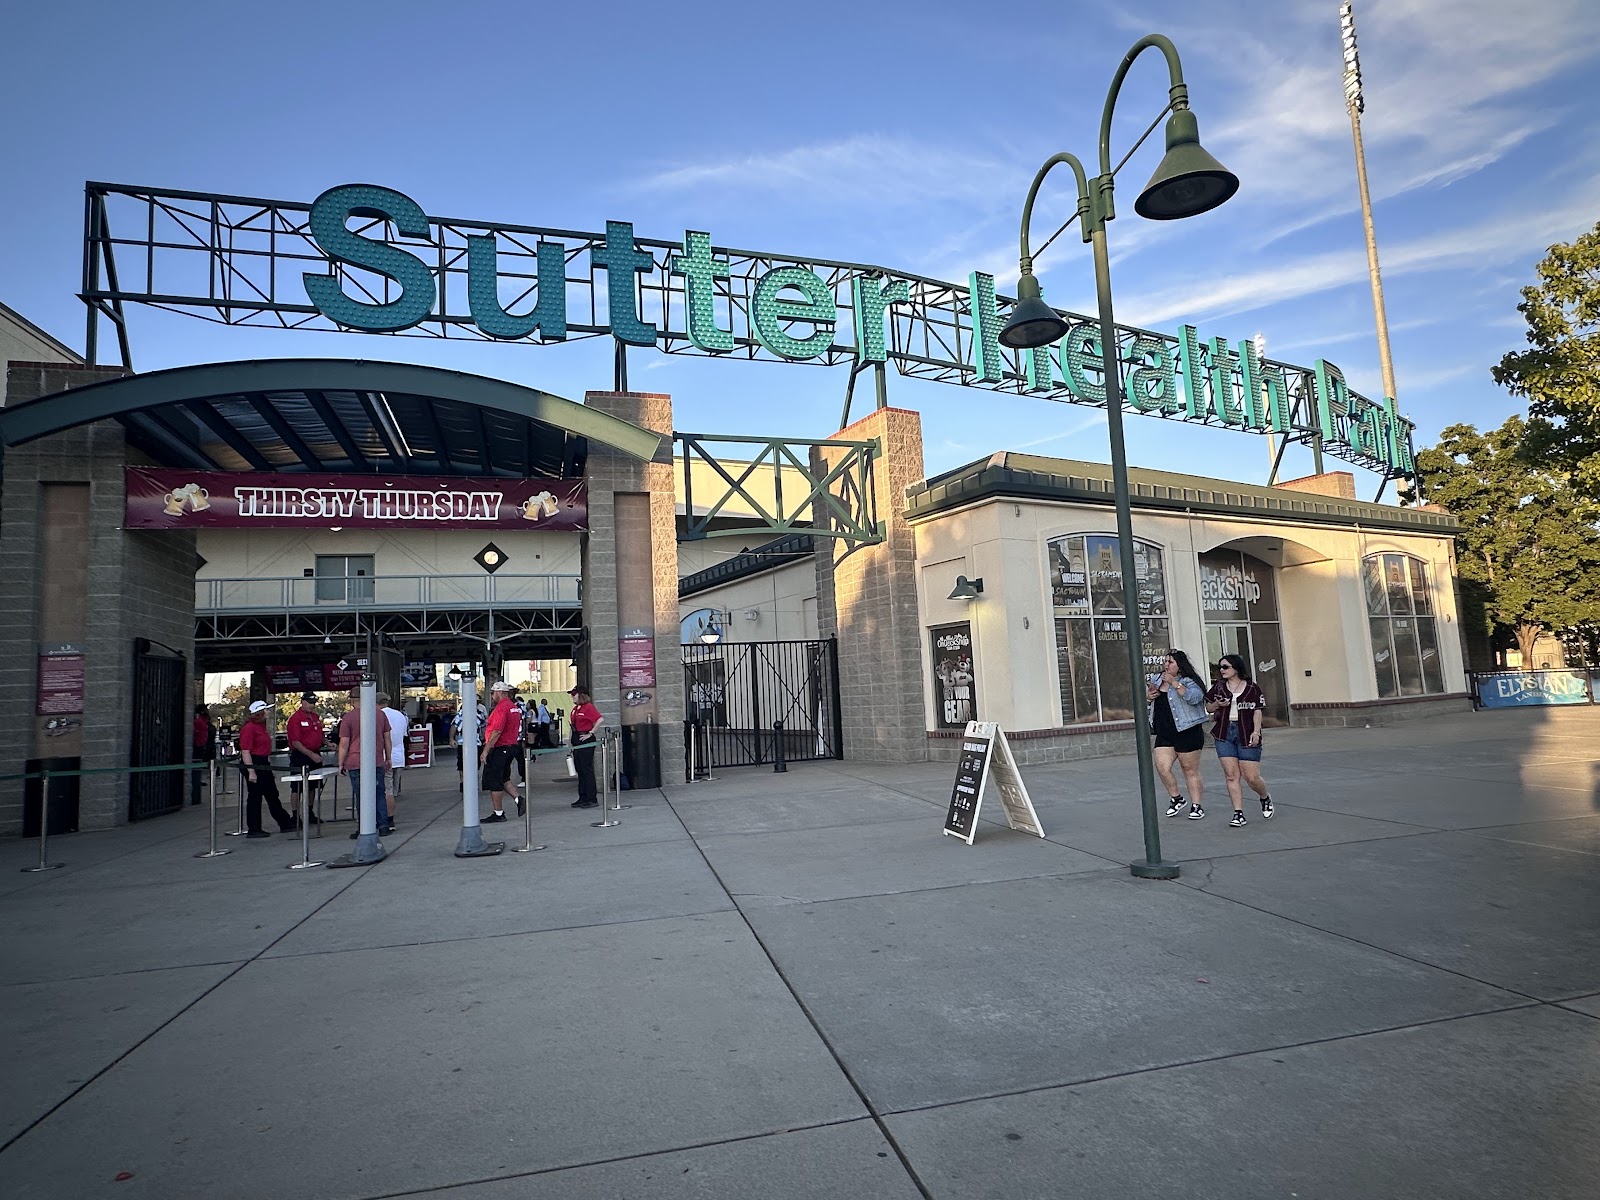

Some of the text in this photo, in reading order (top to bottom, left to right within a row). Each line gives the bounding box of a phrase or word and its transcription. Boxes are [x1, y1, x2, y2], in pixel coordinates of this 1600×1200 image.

[303, 183, 1416, 475] Sutter Health Park
[235, 487, 503, 520] THIRSTY THURSDAY
[1062, 572, 1085, 584] WELCOME
[1090, 570, 1121, 579] SACRAMEN
[1203, 600, 1239, 611] EAM STORE
[1497, 676, 1569, 698] ELYSIAN
[1516, 691, 1555, 702] LANDING
[945, 700, 971, 723] GEAR
